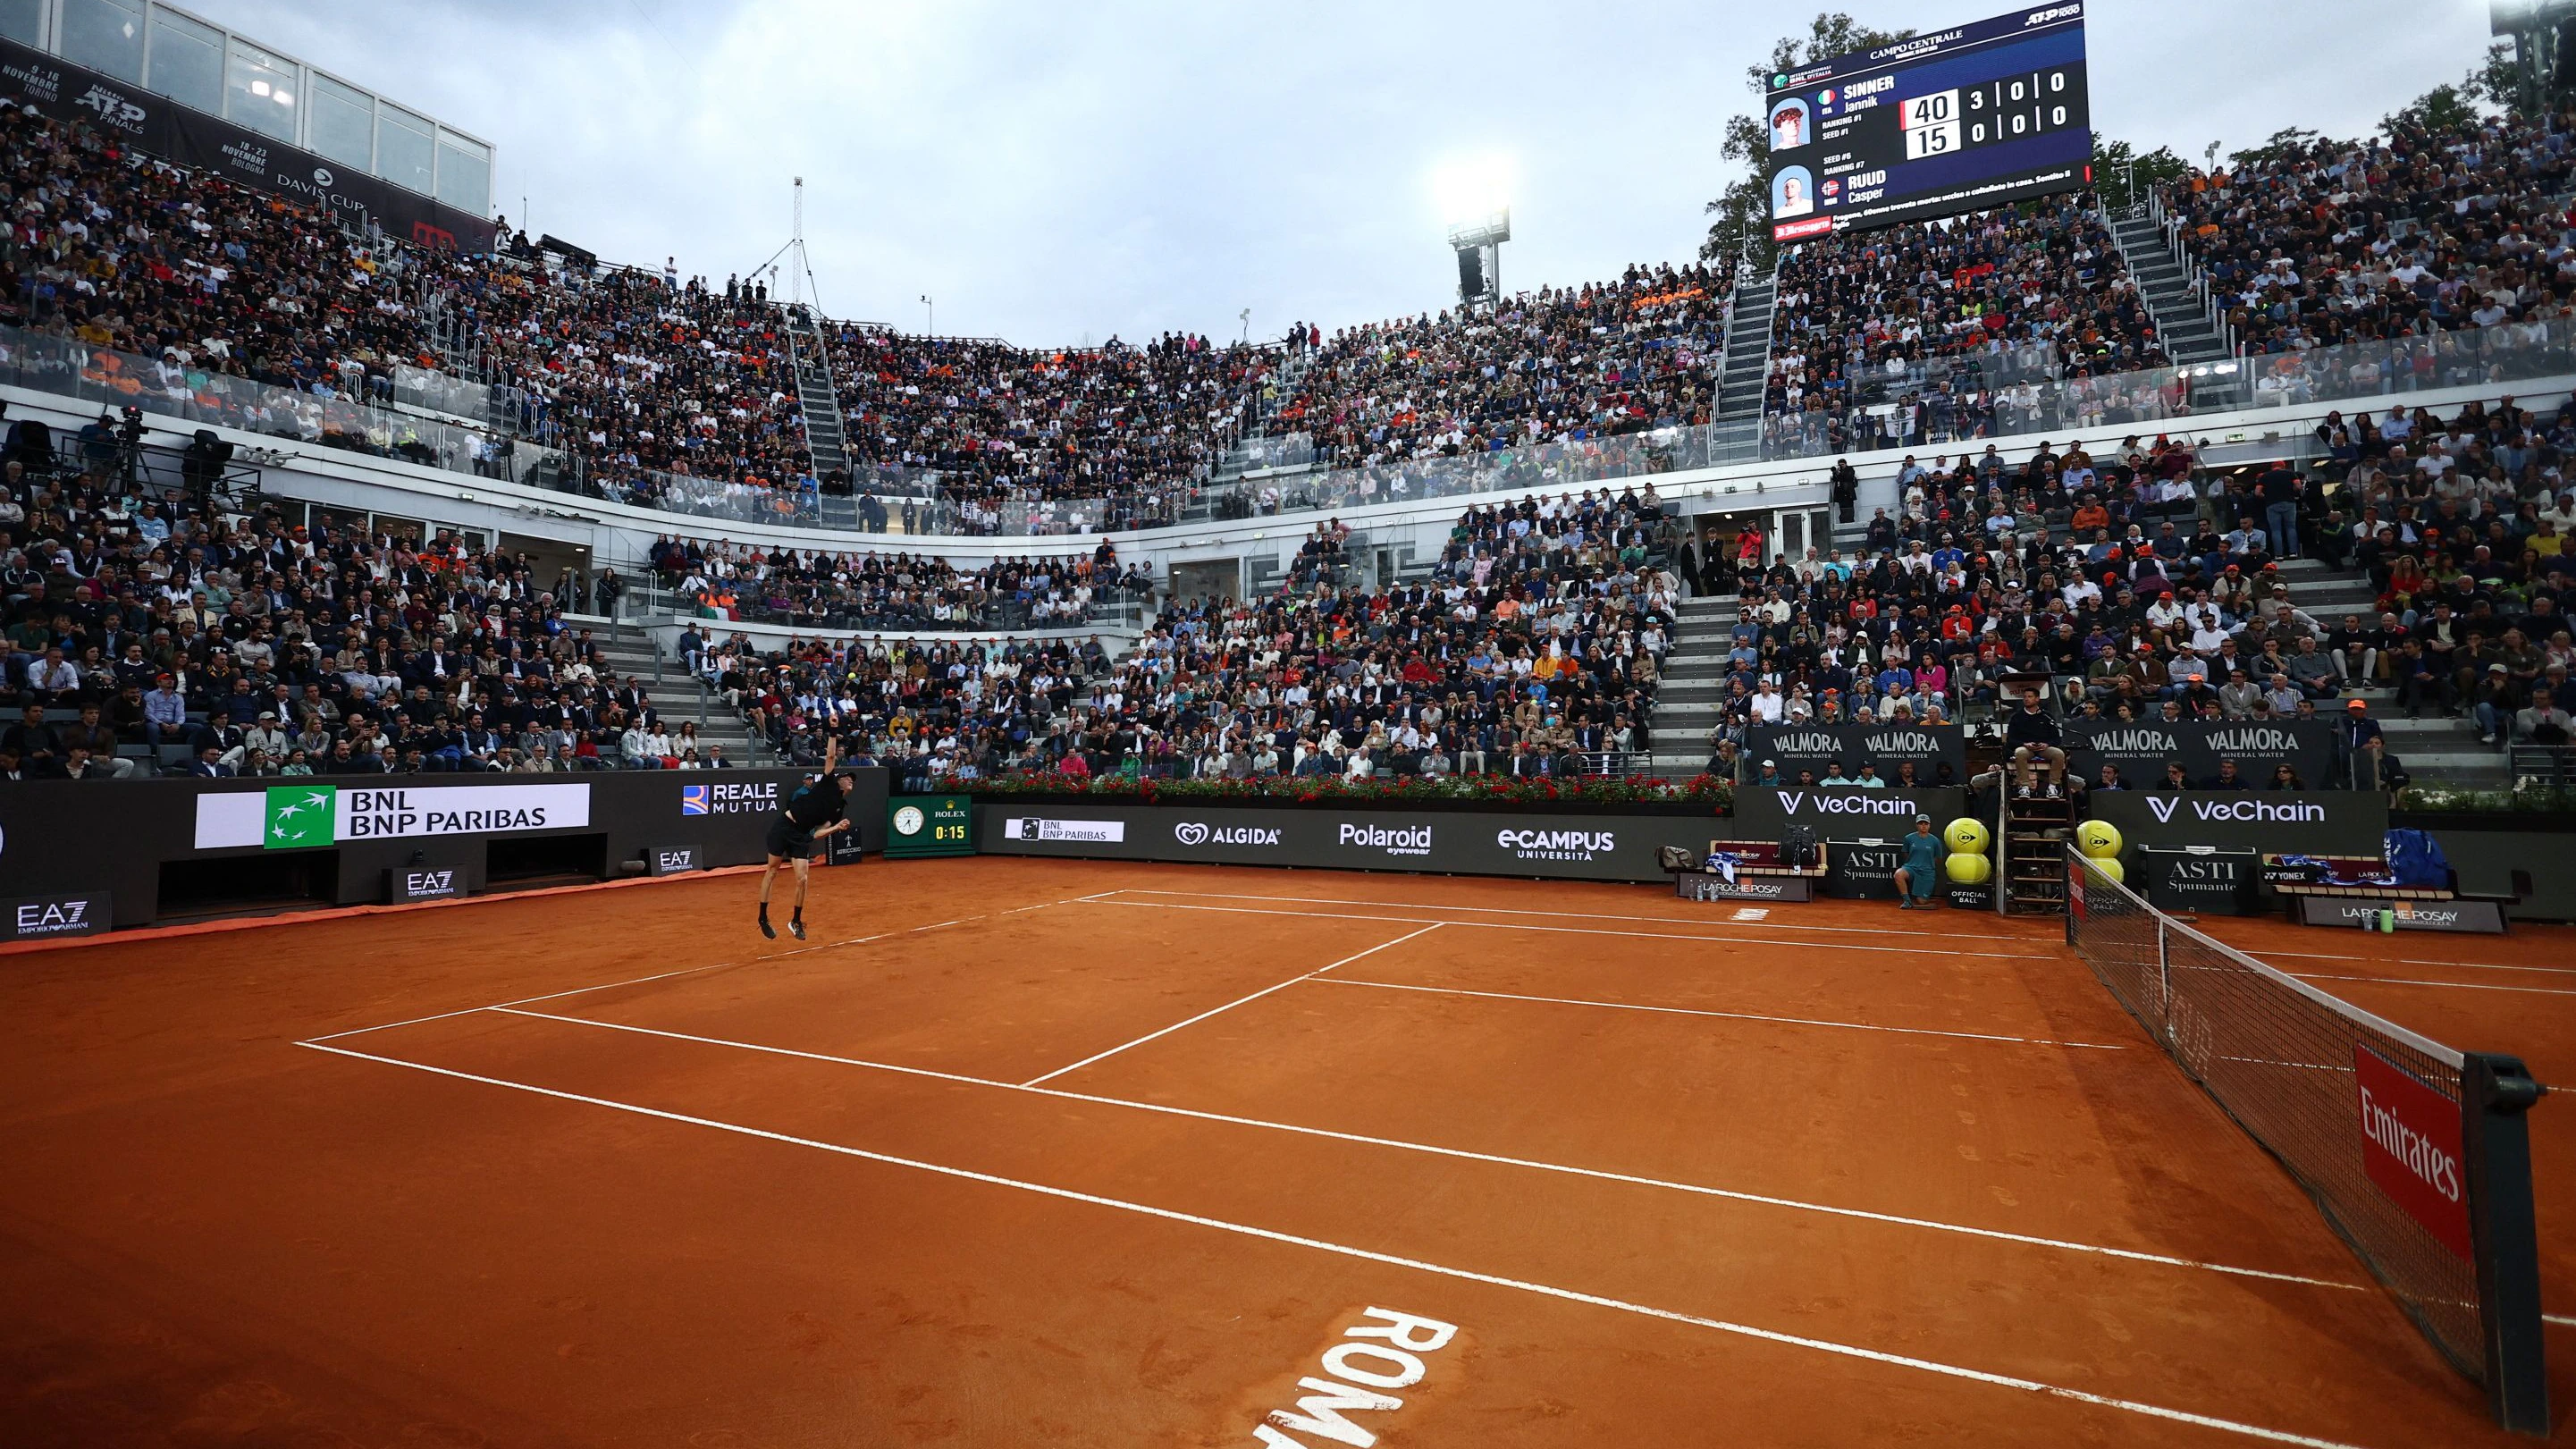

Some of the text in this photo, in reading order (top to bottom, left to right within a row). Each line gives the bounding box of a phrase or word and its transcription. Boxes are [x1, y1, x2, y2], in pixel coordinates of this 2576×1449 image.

[2024, 8, 2058, 27] ATP
[2058, 6, 2080, 18] 1000
[1870, 44, 1907, 60] CAMPO
[1907, 29, 1964, 50] CENTRALE
[2, 64, 59, 92] NOVEMBRE
[31, 64, 38, 73] 9
[47, 72, 60, 81] 16
[24, 83, 58, 103] TORINO
[91, 83, 125, 101] Nitto
[1843, 75, 1895, 100] SINNER
[1970, 72, 2065, 110] 3 0 0
[74, 89, 146, 122] ATP
[1844, 96, 1878, 114] Jannik
[1915, 95, 1949, 122] 40
[99, 113, 145, 134] FINALS
[1822, 114, 1862, 130] RANKING #1
[1971, 105, 2067, 142] 0 0 0
[1823, 128, 1848, 140] SEED #1
[1918, 126, 1947, 155] 15
[222, 144, 266, 166] NOVEMBRE
[240, 141, 249, 150] 18
[257, 147, 267, 157] 23
[231, 157, 265, 176] BOLOGNA
[1823, 155, 1840, 164] SEED
[1824, 161, 1865, 176] RANKING #7
[1848, 170, 1887, 190] RUUD
[277, 173, 365, 212] DAVIS CUP
[1848, 188, 1884, 204] Casper
[1772, 732, 1842, 752] VALMORA
[1865, 731, 1940, 752] VALMORA
[2090, 729, 2178, 751] VALMORA
[2205, 728, 2300, 751] VALMORA
[713, 782, 778, 801] REALE
[351, 791, 415, 813] BNL
[712, 800, 778, 813] MUTUA
[1813, 795, 1915, 815] VeChain
[2192, 800, 2324, 821] VeChain
[349, 807, 546, 837] BNP PARIBAS
[935, 810, 965, 818] ROLEX
[936, 825, 964, 840] 0:15
[1042, 830, 1107, 840] BNP PARIBAS
[1043, 821, 1062, 830] BNL
[1339, 823, 1431, 848] Polaroid
[661, 851, 691, 866] EA7
[1386, 847, 1430, 855] eyewear
[1517, 850, 1593, 861] UNIVERSITÀ
[1844, 851, 1898, 868] ASTI
[1844, 868, 1893, 880] Spumant
[2168, 861, 2235, 880] ASTI
[2277, 872, 2305, 880] YONEX
[408, 871, 453, 891] EA7
[1751, 885, 1782, 894] POSAY
[1951, 890, 1987, 898] OFFICIAL
[17, 900, 88, 927] EA7
[2342, 908, 2361, 917] LA
[2361, 908, 2409, 919] ROHE
[2412, 911, 2458, 922] POSAY
[18, 922, 88, 935] EMPORIO ARMANI
[2361, 1085, 2458, 1202] Emirates
